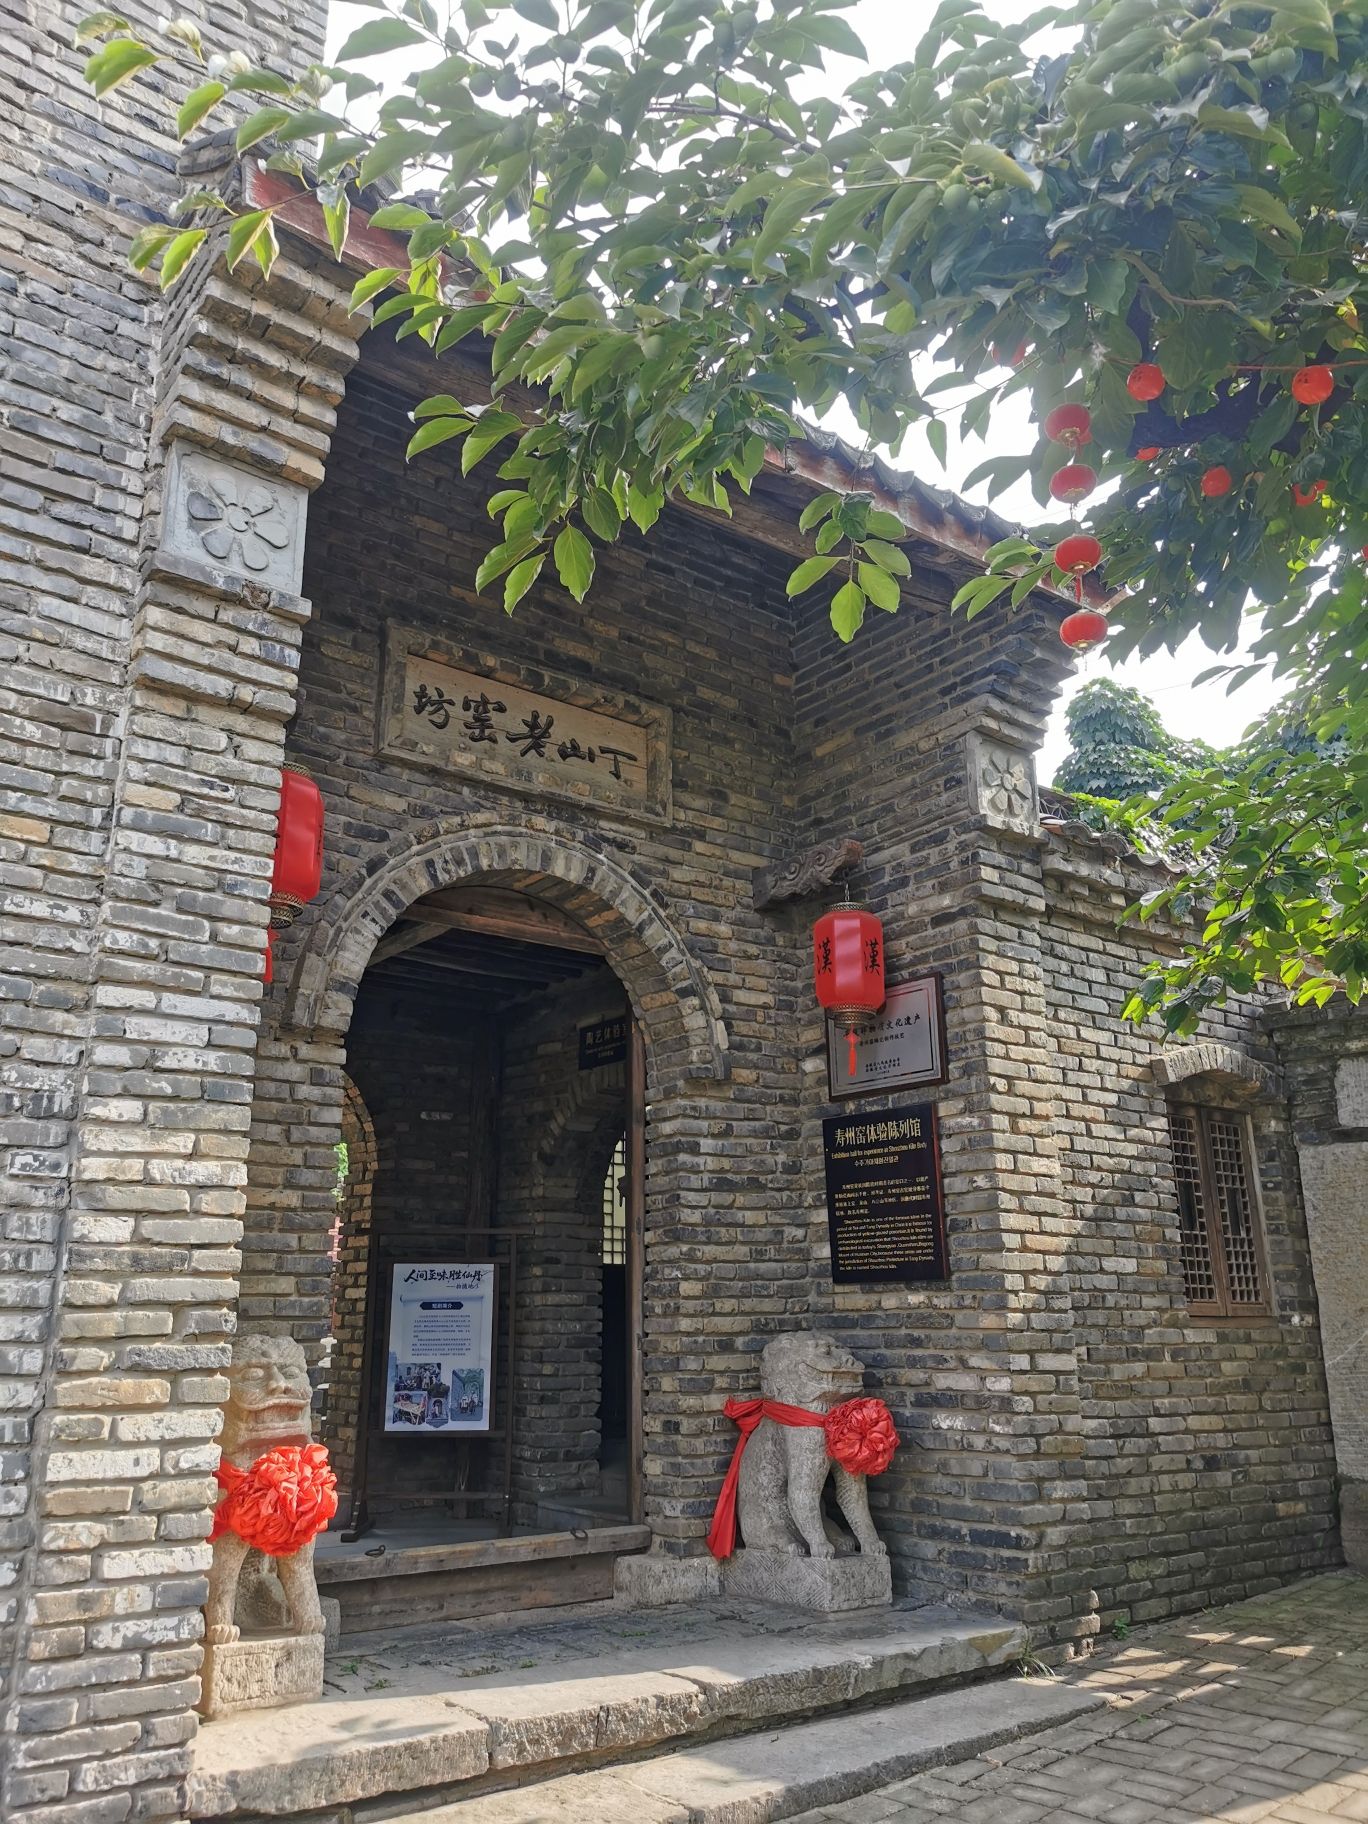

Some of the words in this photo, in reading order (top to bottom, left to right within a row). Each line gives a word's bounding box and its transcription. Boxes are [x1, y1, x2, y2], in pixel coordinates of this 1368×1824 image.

[835, 1118, 922, 1147] 寿州窑体验陈列馆
